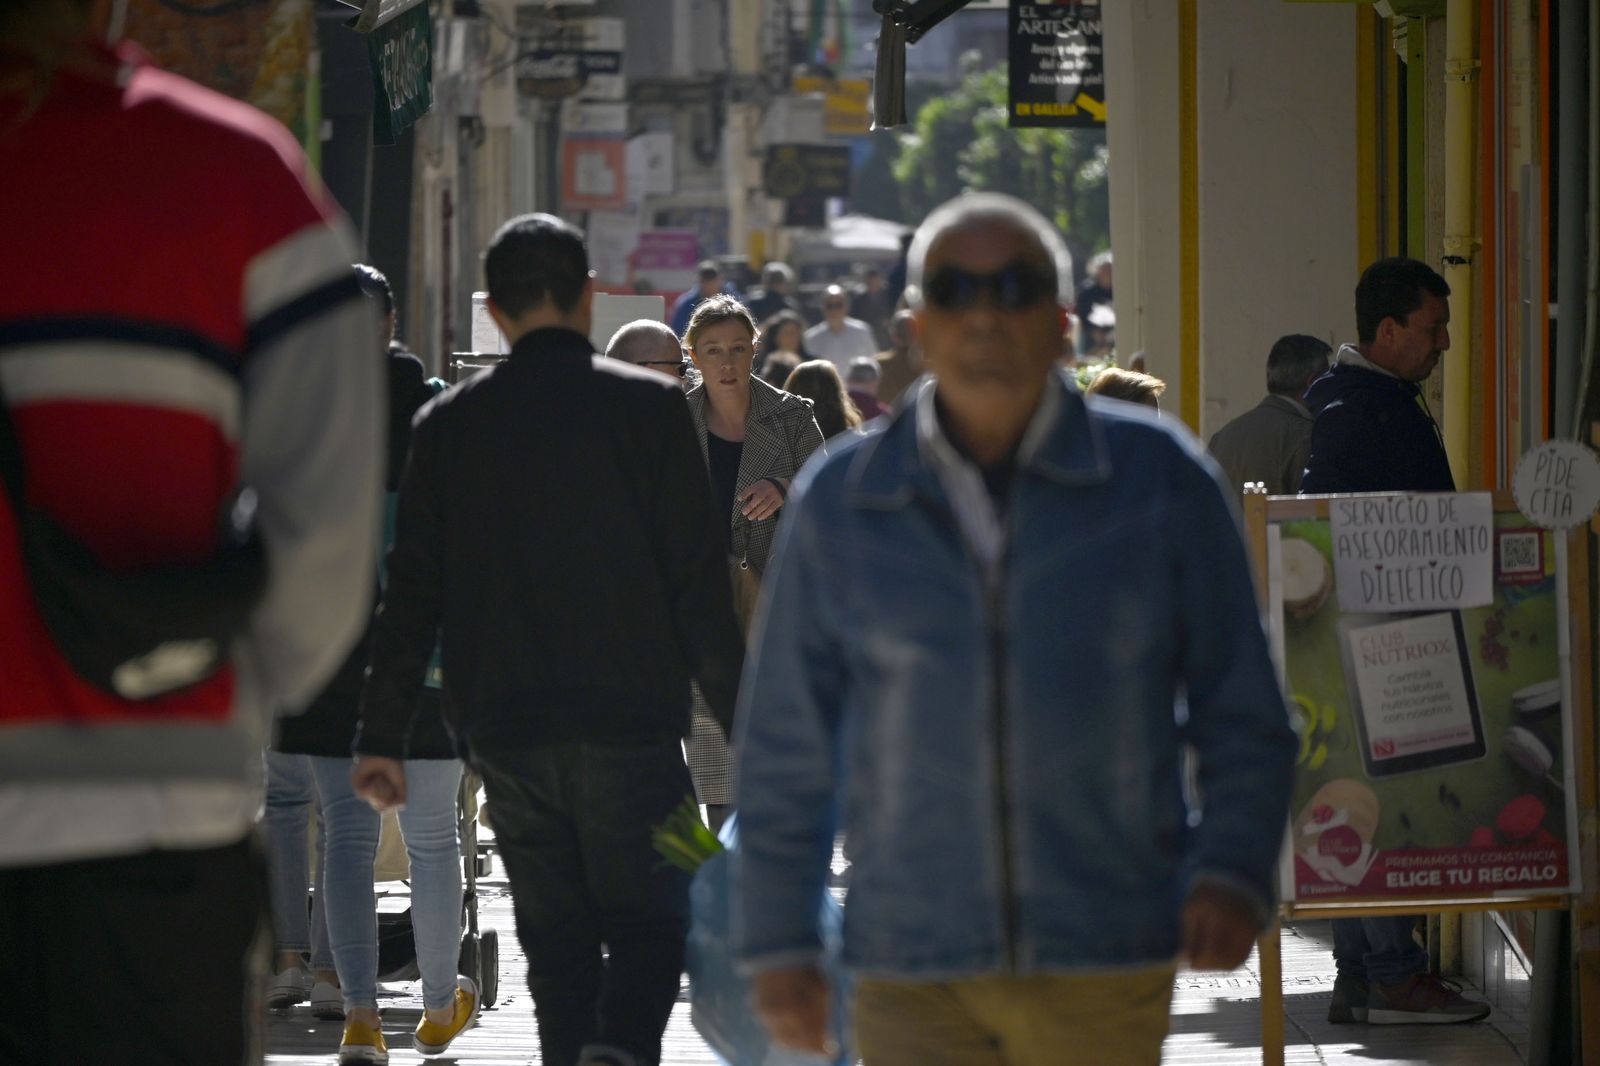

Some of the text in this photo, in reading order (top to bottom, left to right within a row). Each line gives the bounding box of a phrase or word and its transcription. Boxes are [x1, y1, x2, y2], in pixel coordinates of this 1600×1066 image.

[1019, 6, 1038, 18] EL
[1535, 448, 1578, 489] PIDE
[1339, 496, 1459, 527] SERVICIO DE
[1531, 488, 1572, 517] CITA
[1338, 525, 1489, 560] ASESORAMIENTO
[1360, 631, 1405, 652] CLUB
[1362, 639, 1454, 669] NUTRIOX
[1385, 850, 1558, 868] PREMIAMOS TU CONSTANCIA
[1386, 865, 1558, 888] ELIGE TU REGALO
